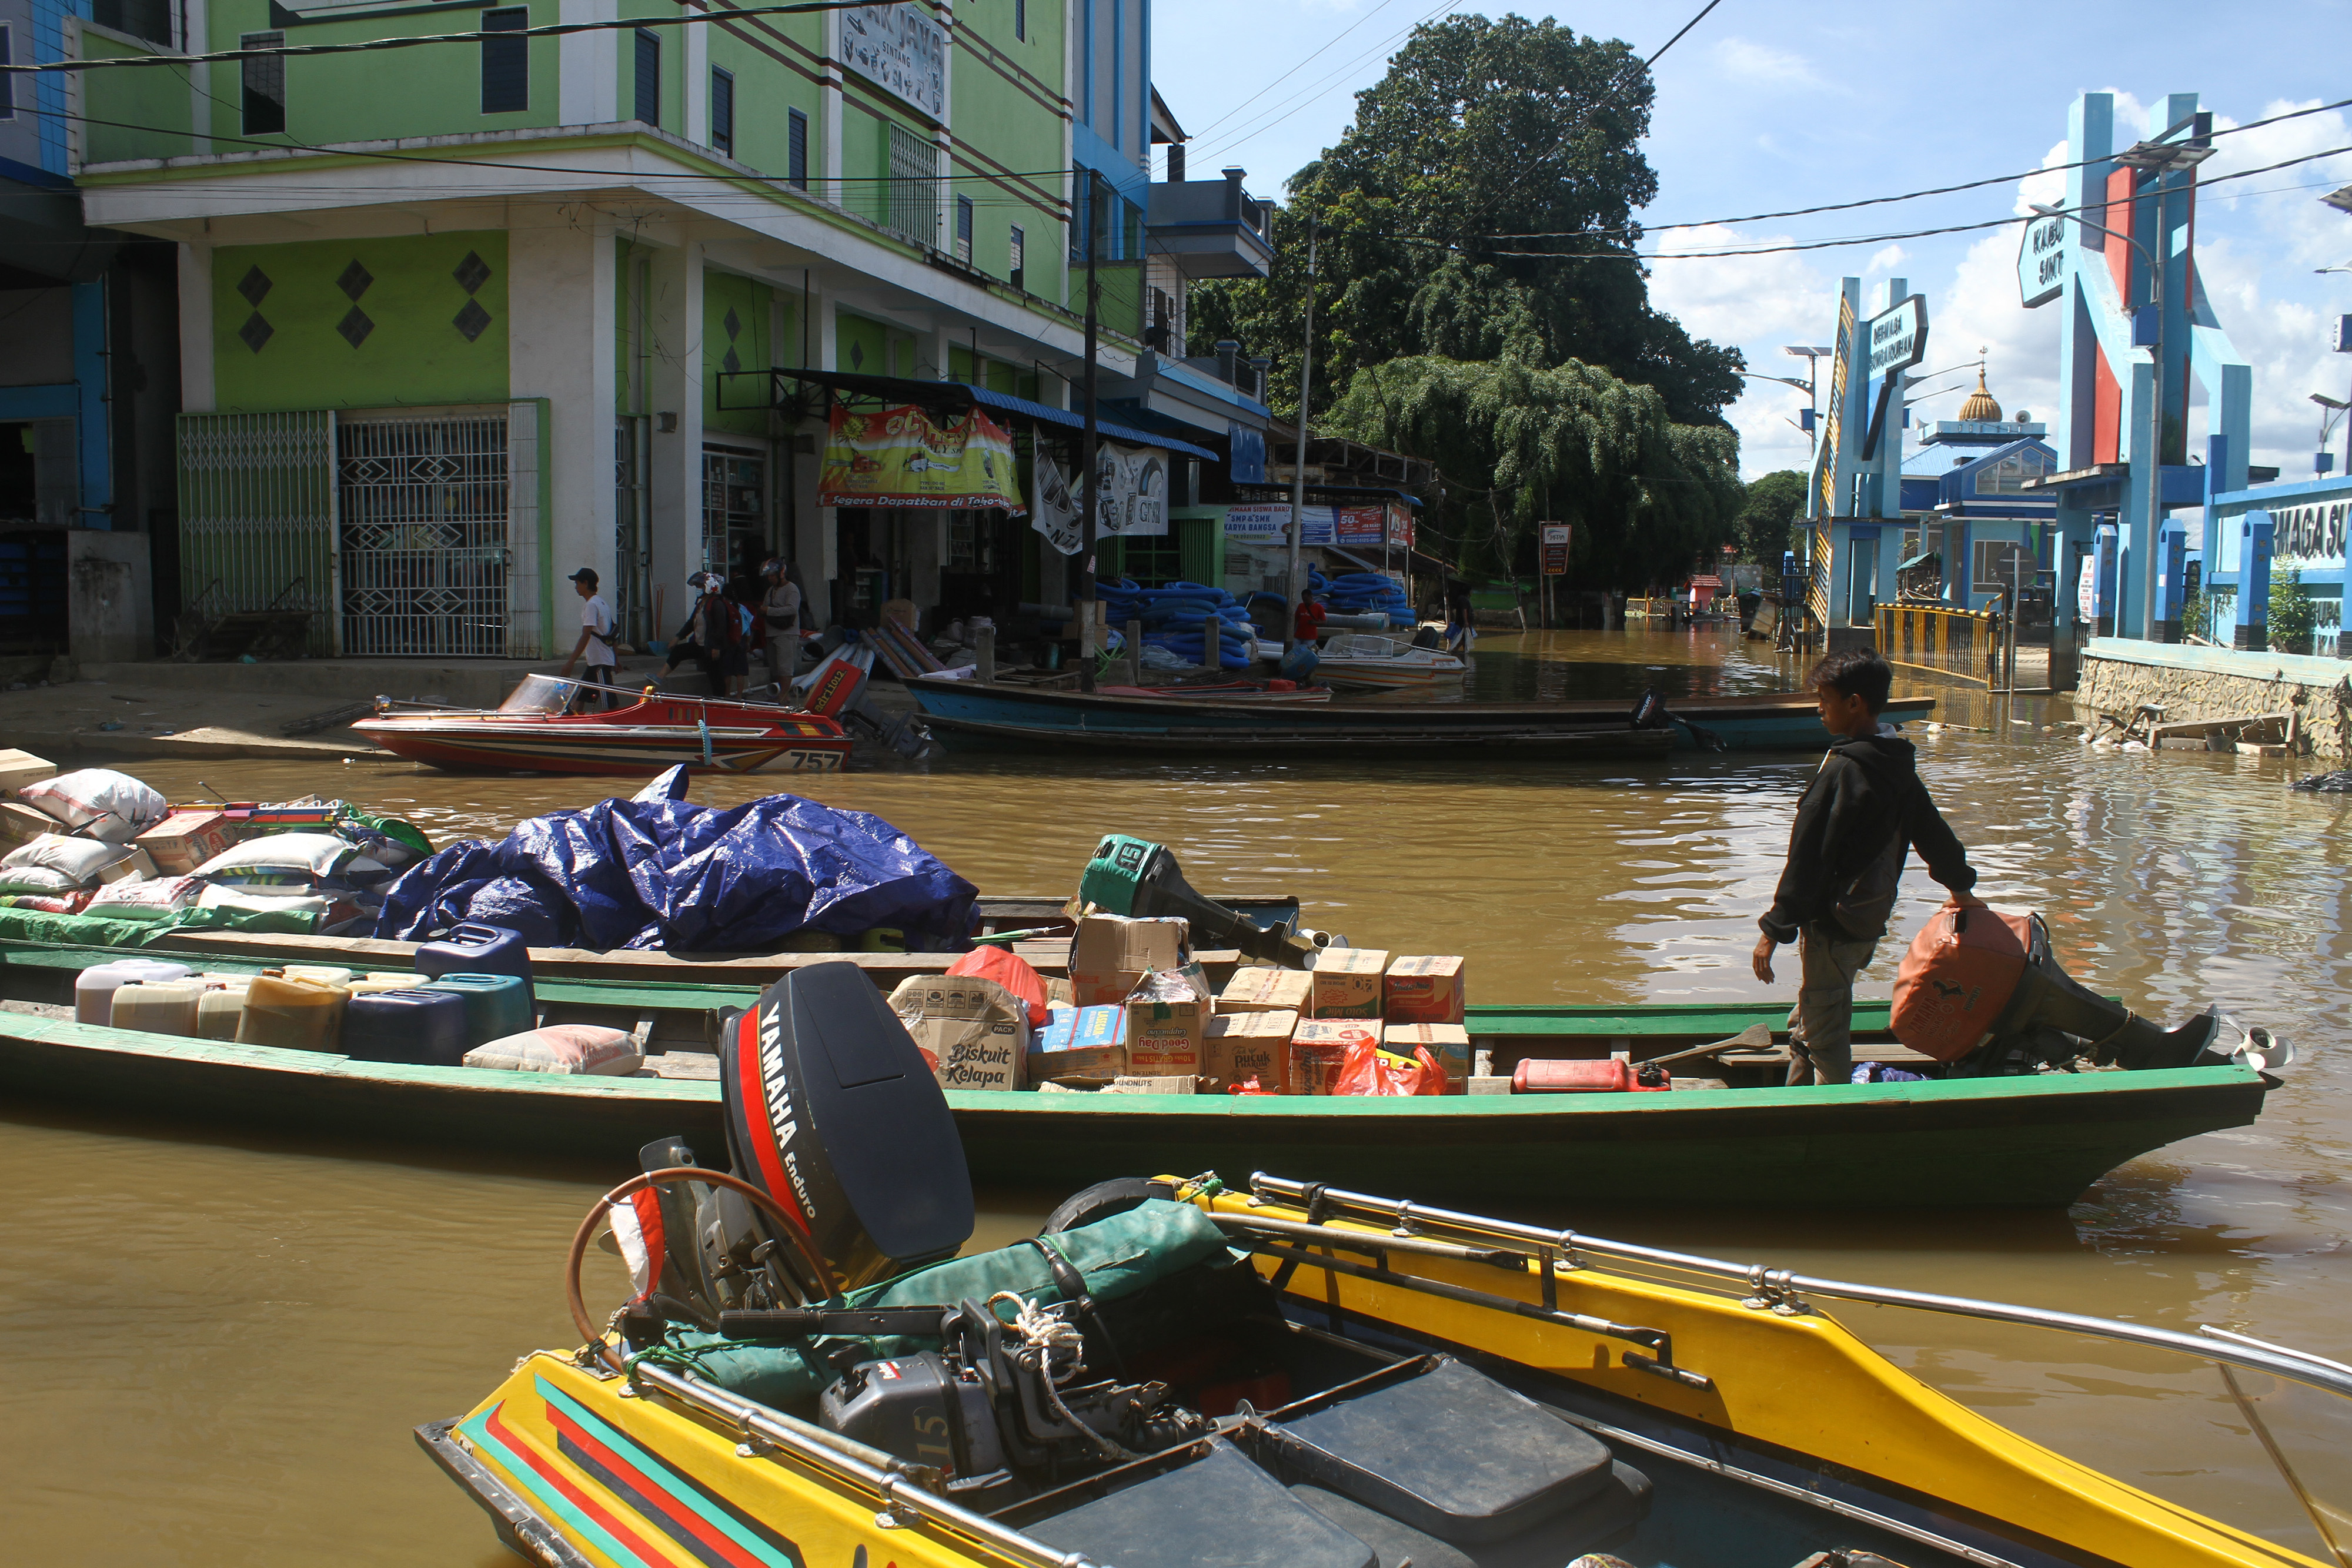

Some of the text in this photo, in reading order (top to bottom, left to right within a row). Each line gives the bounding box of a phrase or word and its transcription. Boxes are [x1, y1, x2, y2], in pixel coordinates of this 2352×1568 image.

[899, 6, 941, 66] JAYA
[883, 41, 910, 68] SINTANG
[2033, 217, 2064, 256] KABU
[2039, 249, 2064, 286] SINT
[832, 495, 874, 506] Segera
[878, 496, 947, 507] Dapatkan
[950, 497, 964, 506] di
[790, 751, 841, 771] 757
[1120, 847, 1141, 864] 15
[1092, 1011, 1110, 1037] LASEGAR
[1906, 996, 1941, 1035] YAMAHA
[1138, 1035, 1190, 1051] Good Day
[1146, 1027, 1187, 1037] Cappuccino
[947, 1043, 1012, 1065] Biskuit
[761, 999, 797, 1151] YAMAHA
[946, 1064, 1006, 1088] Kelapa
[784, 1151, 816, 1219] Enduro
[914, 1415, 951, 1460] 15
